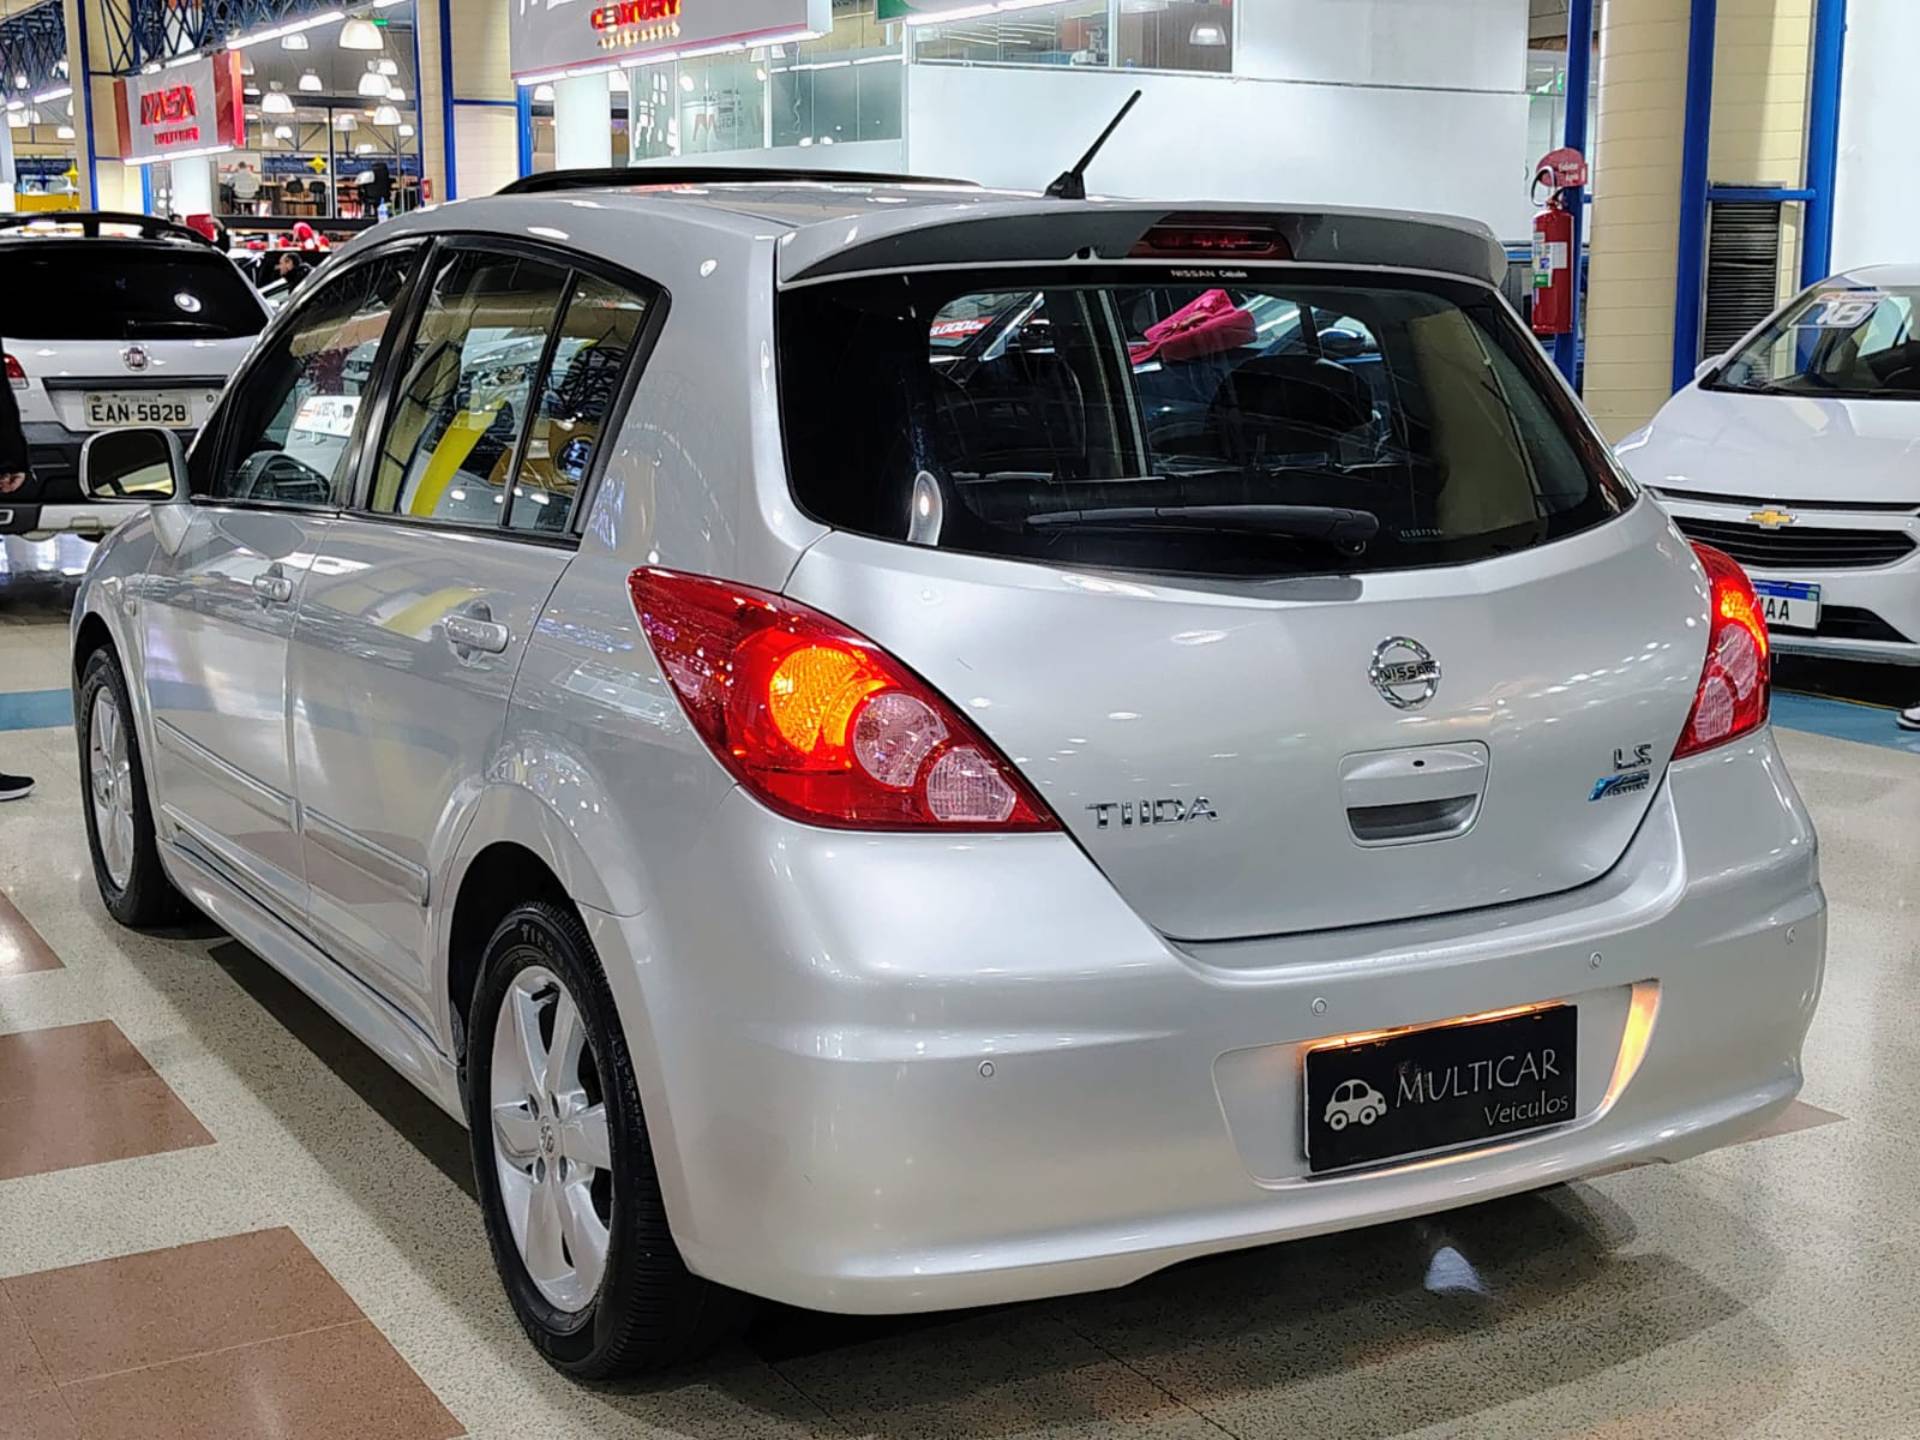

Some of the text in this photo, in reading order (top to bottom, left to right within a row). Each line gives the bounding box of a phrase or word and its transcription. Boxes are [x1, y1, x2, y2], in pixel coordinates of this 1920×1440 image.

[1613, 744, 1652, 771] LS
[1085, 796, 1219, 829] TIIDA
[1397, 1048, 1560, 1109] MULTICAR
